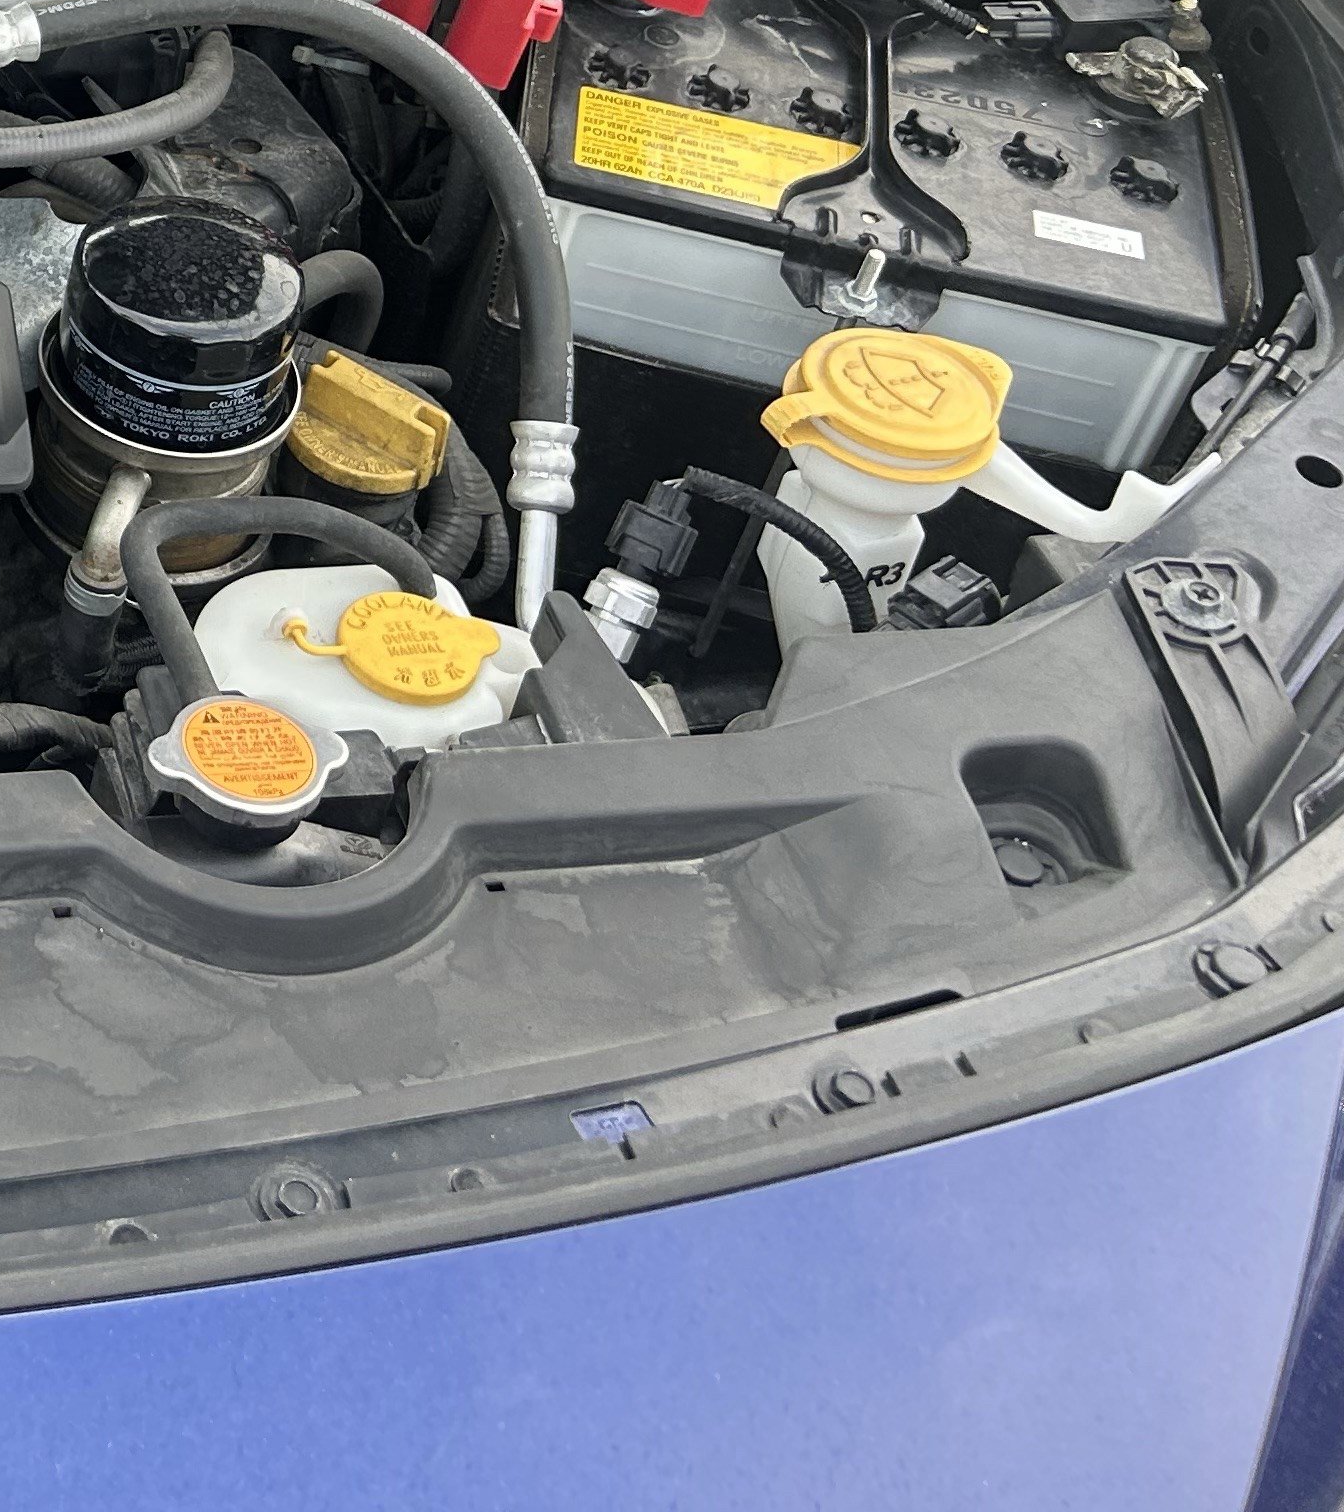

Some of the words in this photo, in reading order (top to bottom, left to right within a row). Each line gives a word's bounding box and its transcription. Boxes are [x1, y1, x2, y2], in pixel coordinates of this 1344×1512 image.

[586, 90, 642, 109] DANGER
[583, 125, 638, 144] POISON
[647, 170, 674, 184] CCA
[677, 177, 706, 191] 470A
[208, 392, 256, 409] CAUTION
[121, 418, 170, 440] TOKYO
[177, 433, 214, 443] ROKI
[865, 561, 906, 588] R3
